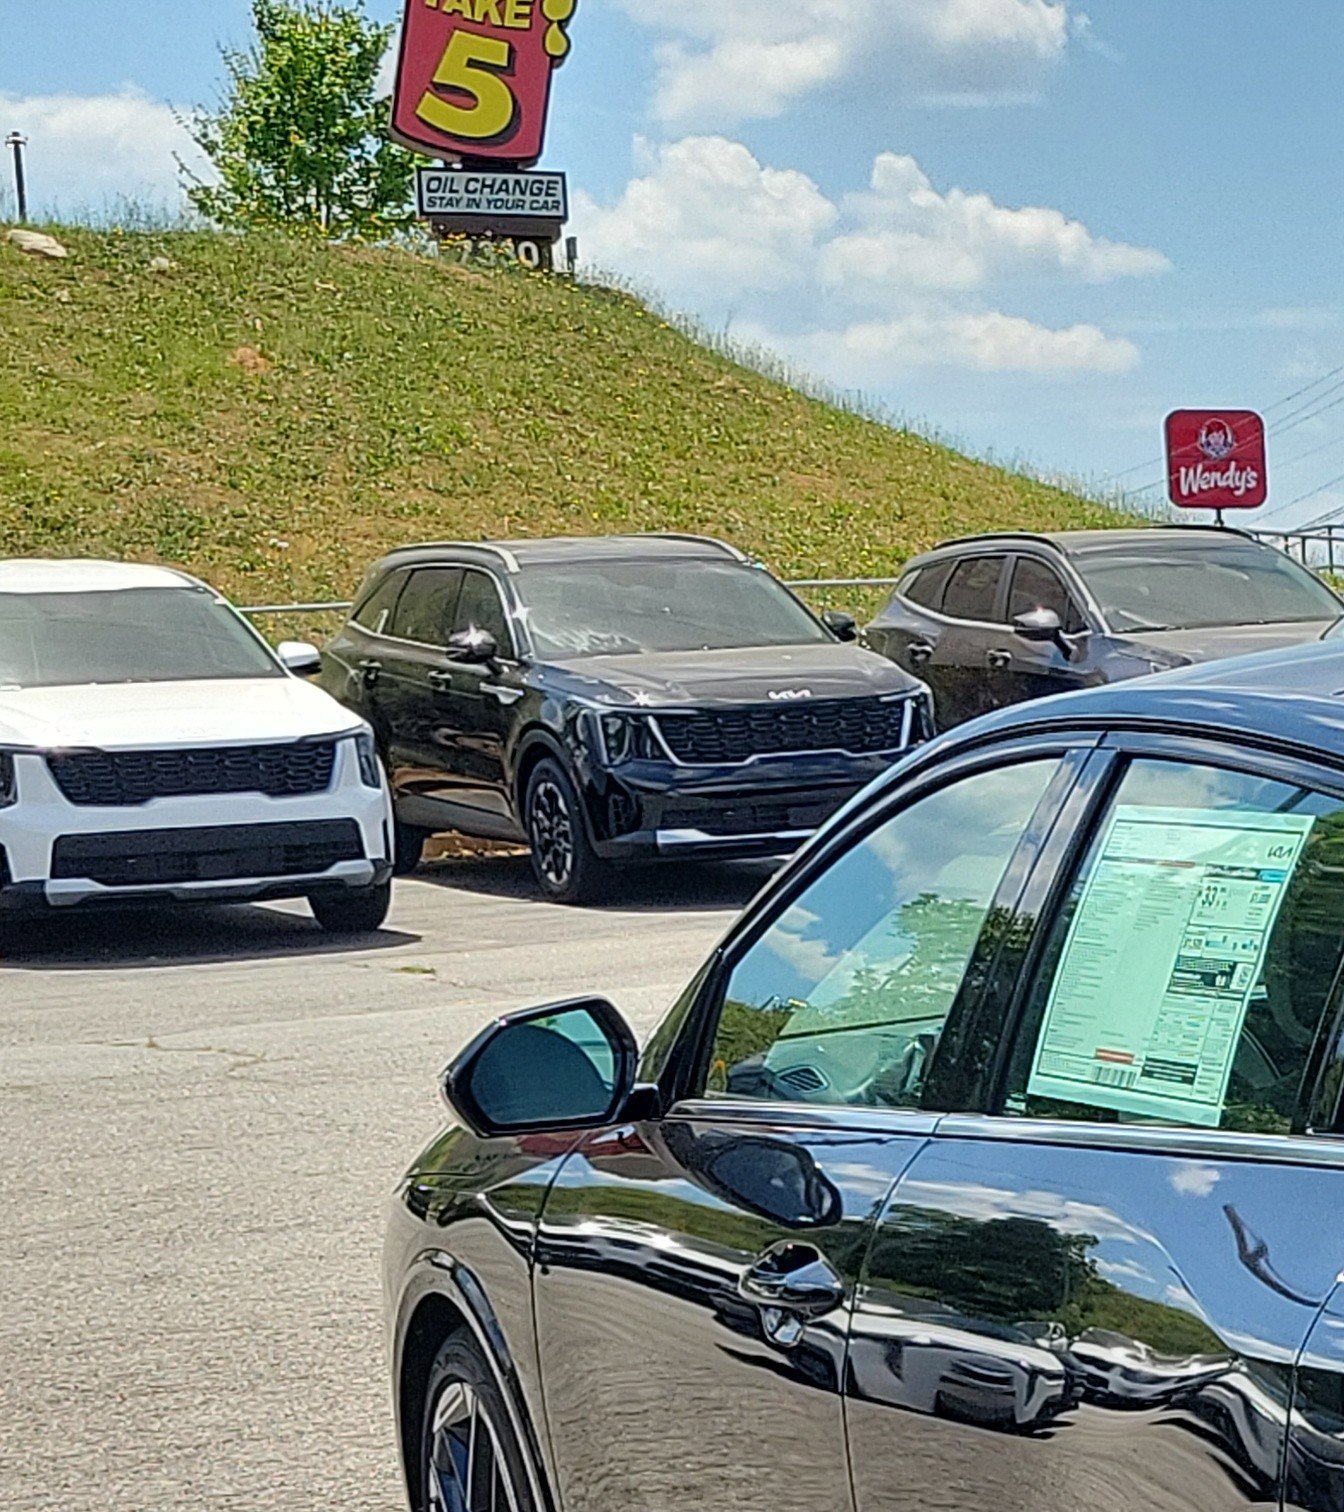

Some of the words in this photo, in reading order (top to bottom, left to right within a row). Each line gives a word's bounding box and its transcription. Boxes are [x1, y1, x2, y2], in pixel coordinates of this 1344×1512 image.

[415, 30, 514, 138] 5
[426, 176, 459, 194] OIL
[464, 176, 559, 197] CHANGE
[426, 196, 463, 208] STAY
[466, 198, 482, 210] IN
[485, 198, 525, 211] YOUR
[529, 199, 561, 212] CAR
[1179, 461, 1258, 496] Wendy's
